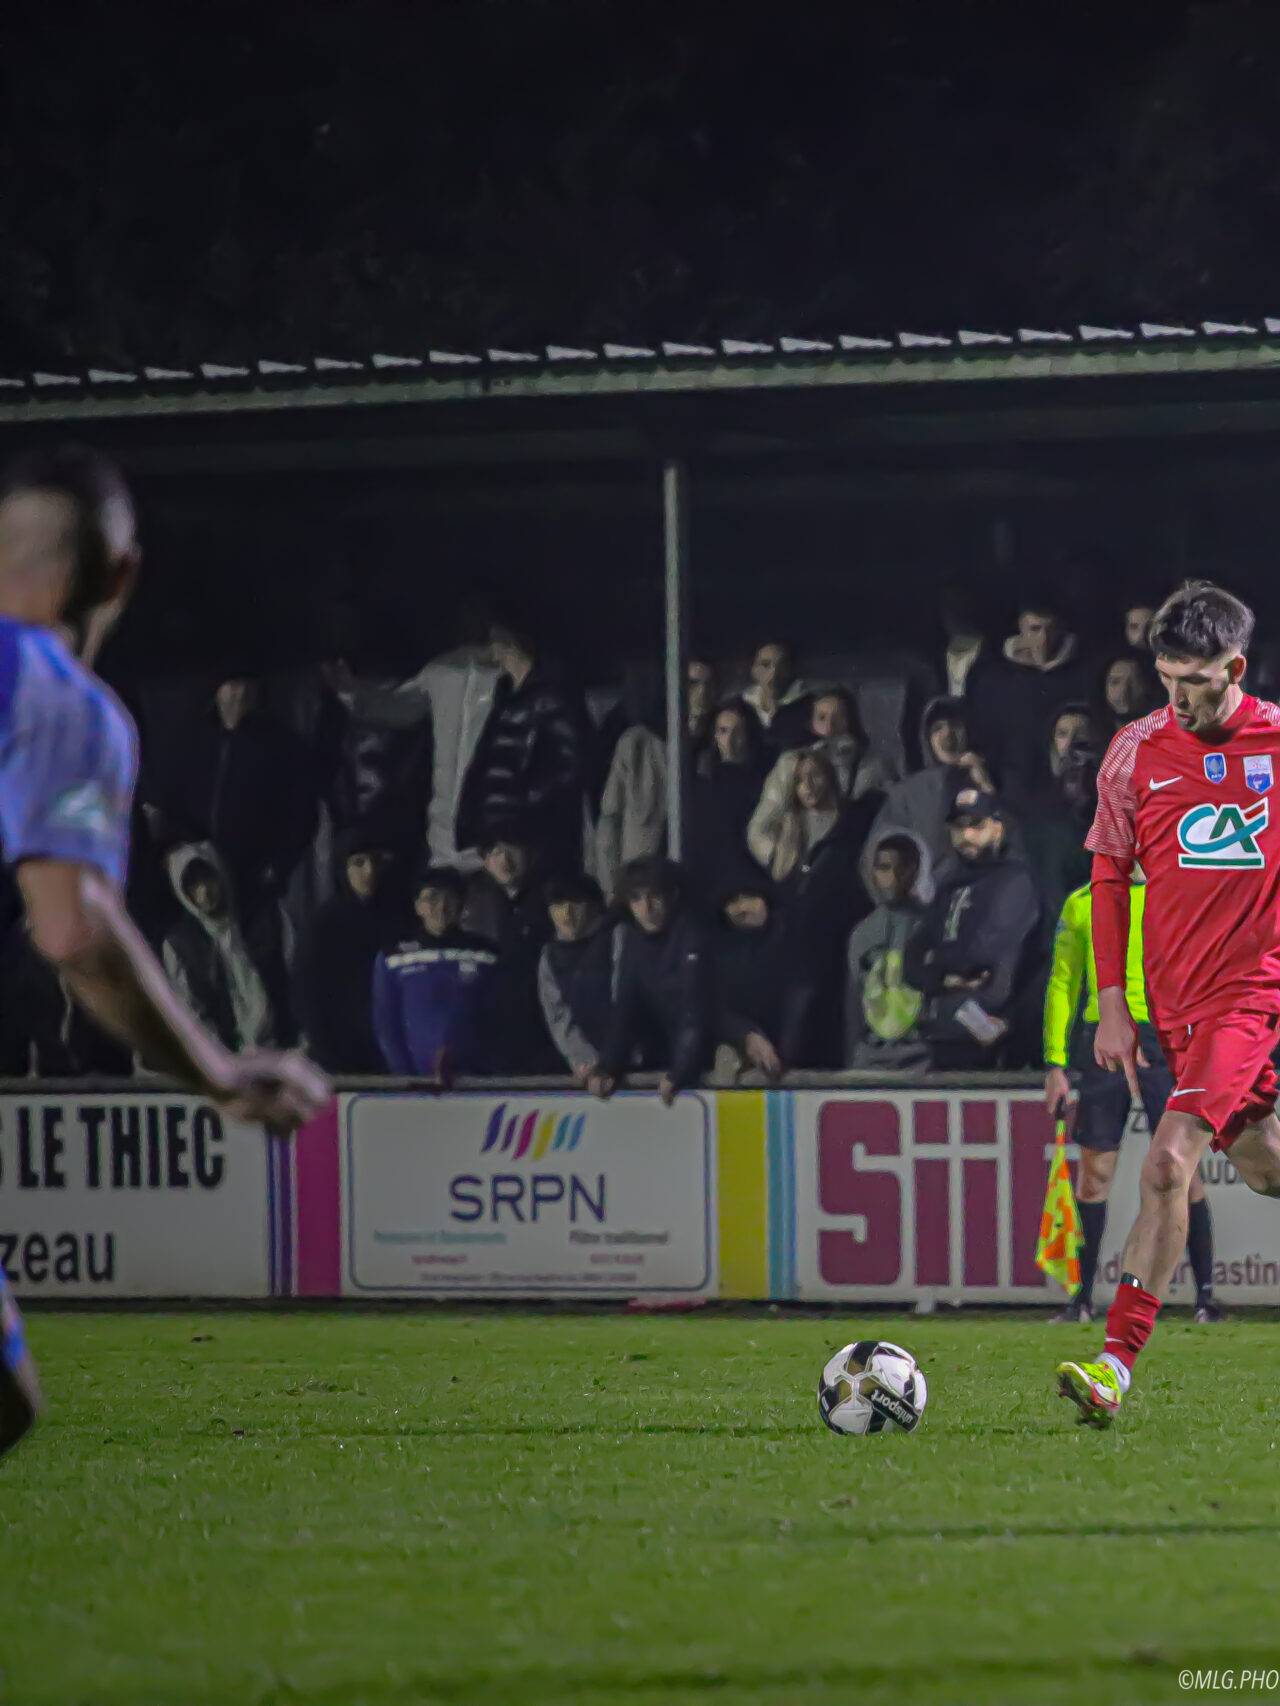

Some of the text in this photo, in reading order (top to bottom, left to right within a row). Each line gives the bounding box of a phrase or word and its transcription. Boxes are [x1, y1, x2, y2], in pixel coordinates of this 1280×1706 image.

[17, 1105, 227, 1190] LE THIEC
[449, 1173, 607, 1224] SRPN
